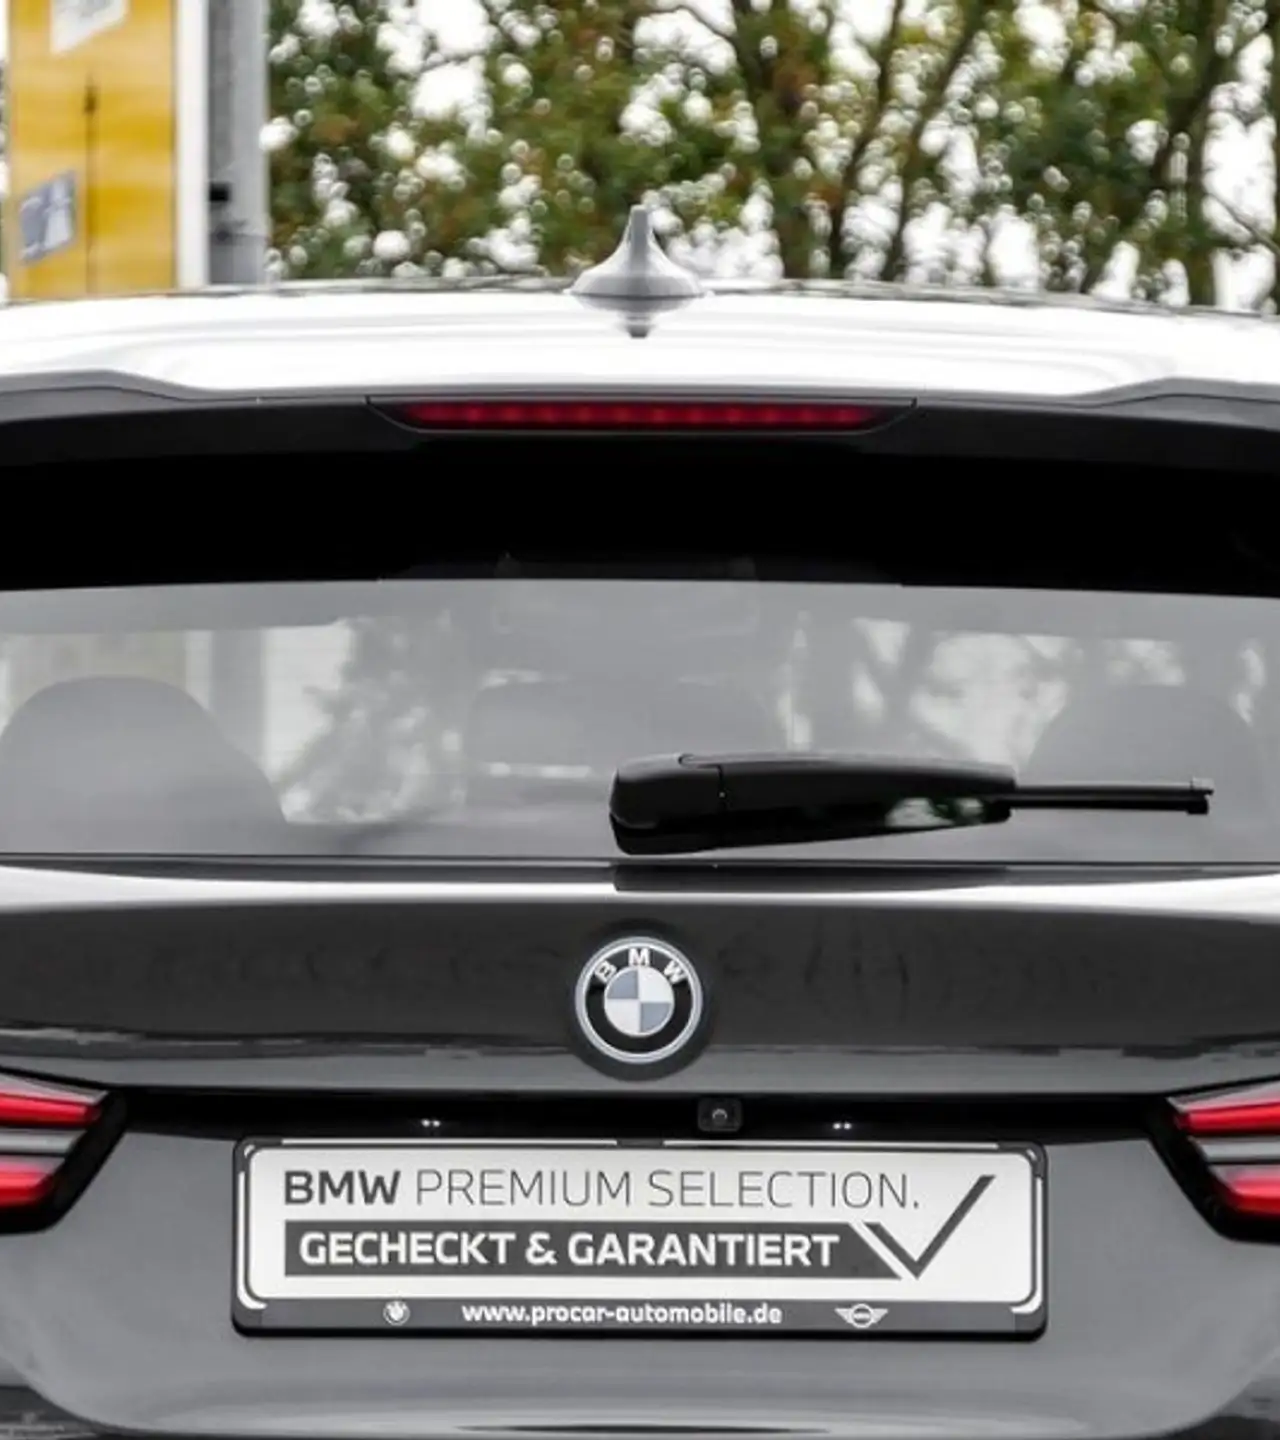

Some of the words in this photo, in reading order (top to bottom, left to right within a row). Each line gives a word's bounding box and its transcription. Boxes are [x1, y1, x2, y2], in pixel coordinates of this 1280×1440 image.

[593, 946, 688, 985] BMW
[284, 1169, 402, 1206] BMW
[416, 1168, 632, 1208] PREMIUM
[647, 1169, 921, 1209] SELECTION.
[298, 1231, 517, 1266] GECHECKT
[524, 1231, 558, 1266] &
[567, 1232, 840, 1268] GARANTIERT
[461, 1303, 783, 1327] www.procar-automobile.de
